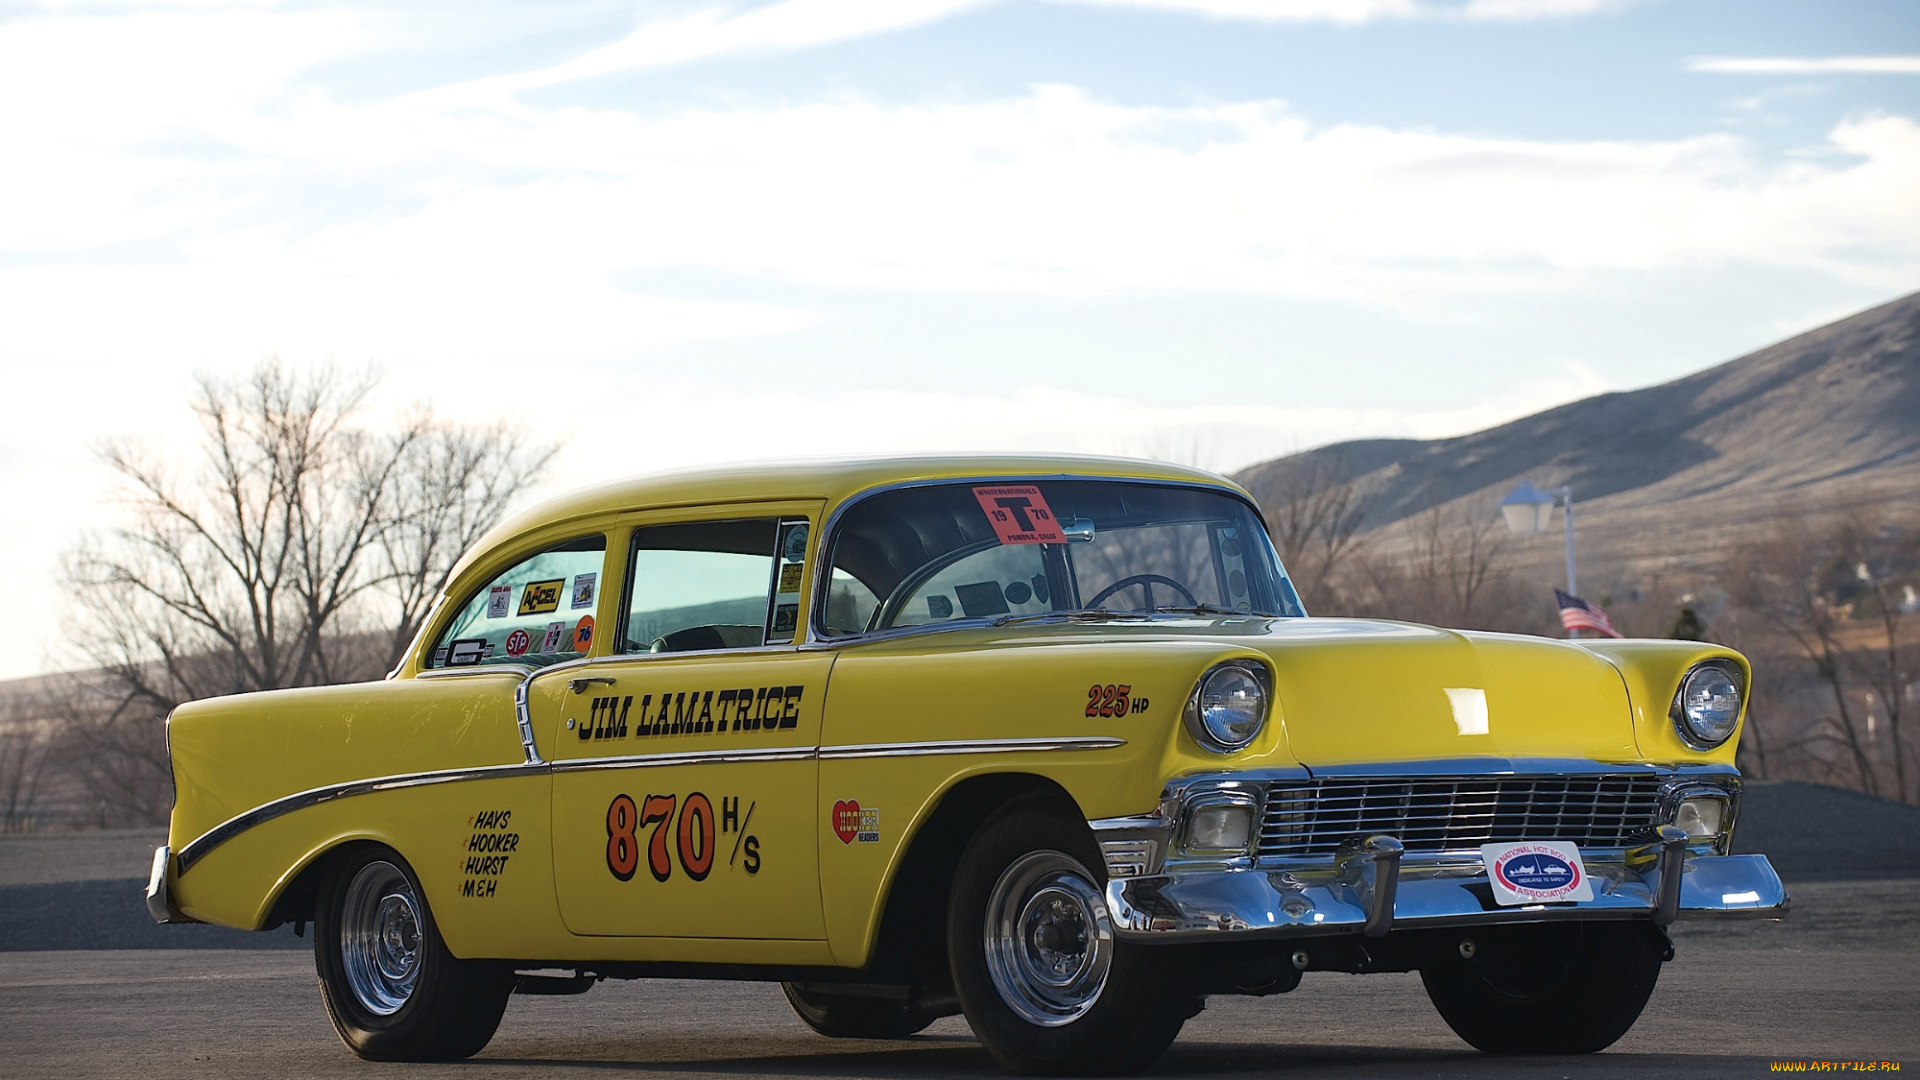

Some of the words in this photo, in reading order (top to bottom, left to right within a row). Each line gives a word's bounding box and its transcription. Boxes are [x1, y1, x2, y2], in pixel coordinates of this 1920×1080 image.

[977, 488, 1037, 496] WINTERNATIONALS
[991, 510, 1008, 521] 19
[1031, 509, 1049, 520] 70
[993, 497, 1036, 531] T
[507, 632, 527, 652] STP
[578, 626, 591, 642] 76
[1085, 684, 1131, 718] 225
[1131, 698, 1149, 713] HP
[578, 696, 633, 740] JIM
[636, 685, 804, 737] LAMATRICE
[473, 810, 511, 829] HAYS
[840, 811, 879, 831] HOOKER
[468, 833, 519, 852] HOOKER
[606, 792, 716, 882] 870
[1499, 846, 1531, 862] NATIONAL
[1533, 845, 1548, 854] HOT
[1550, 849, 1567, 860] ROD
[465, 856, 509, 875] HURST
[1517, 886, 1571, 898] ASSOCIATION
